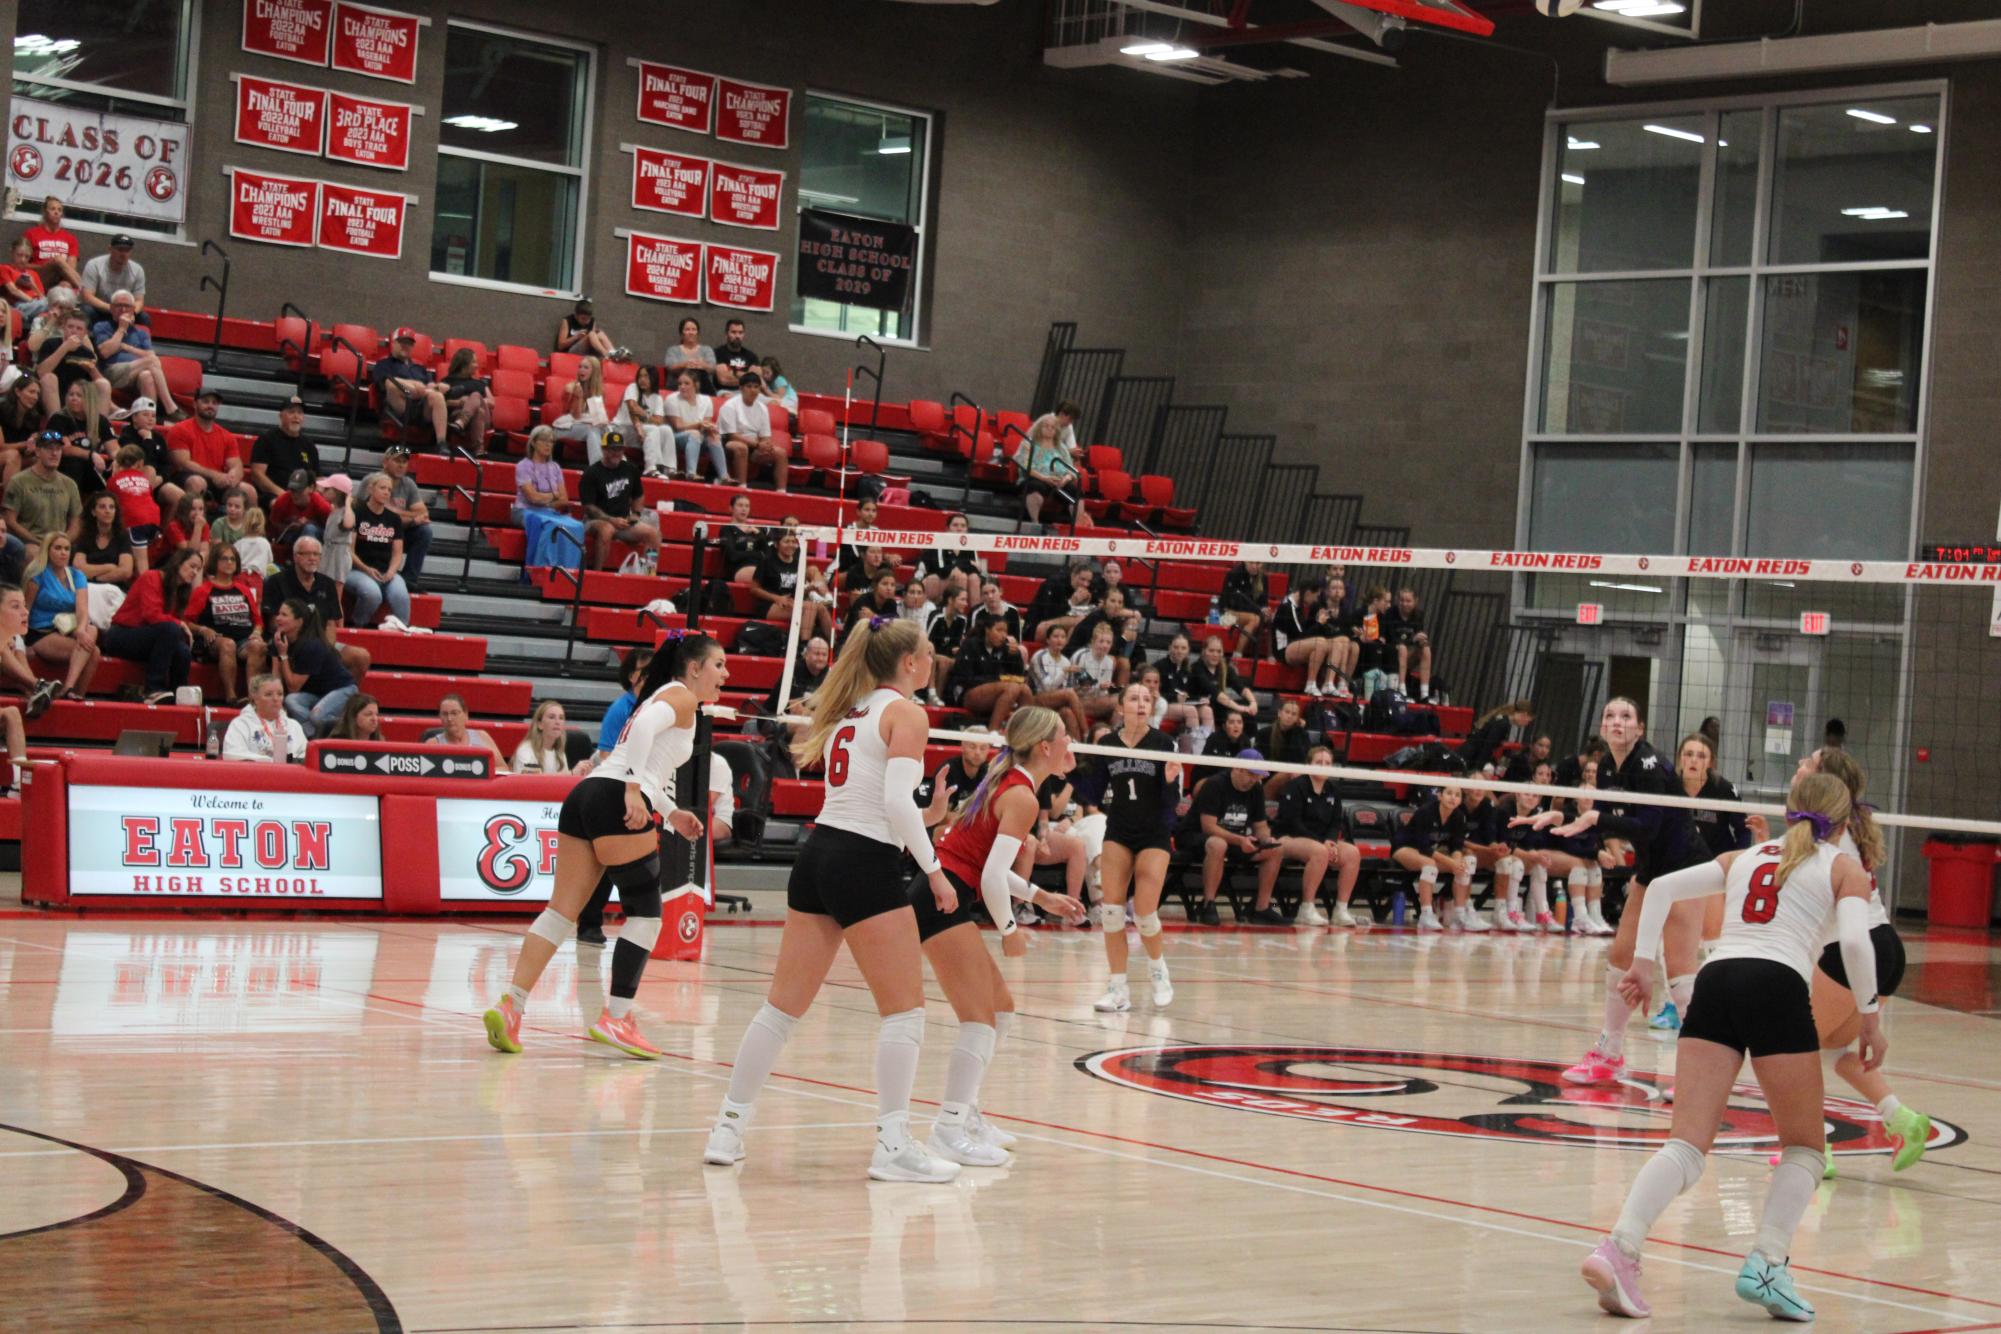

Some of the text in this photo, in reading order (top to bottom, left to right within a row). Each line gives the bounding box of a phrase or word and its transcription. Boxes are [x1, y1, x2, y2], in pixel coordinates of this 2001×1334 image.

[256, 0, 322, 31] CHAMPIONS
[365, 16, 391, 28] STATE
[269, 30, 304, 45] FOOTBALL
[344, 17, 408, 48] CHAMPIONS
[276, 41, 296, 52] EATON
[356, 39, 393, 54] 2023 AAA
[357, 50, 391, 64] BASEBALL
[364, 60, 383, 71] EATON
[669, 73, 687, 83] STATE
[269, 87, 296, 101] STATE
[646, 74, 707, 103] FINAL FOUR
[744, 90, 766, 101] STATE
[248, 89, 315, 122] FINAL FOUR
[356, 105, 382, 117] STATE
[726, 92, 781, 117] CHAMPIONS
[336, 108, 399, 136] 3RD PLACE
[666, 111, 683, 121] EATON
[757, 112, 770, 123] AAA
[258, 120, 300, 137] VOLLEYBALL
[347, 127, 385, 142] 2023 AAA
[742, 129, 761, 139] EATON
[12, 114, 179, 164] CLASS OF
[268, 133, 289, 144] EATON
[343, 137, 387, 152] BOYS TRACK
[355, 149, 375, 160] EATON
[663, 158, 682, 168] STATE
[54, 155, 133, 190] 2026
[640, 159, 702, 186] FINAL FOUR
[738, 174, 757, 184] STATE
[261, 181, 289, 194] STATE
[672, 180, 686, 190] AAA
[716, 174, 777, 200] FINAL FOUR
[240, 182, 308, 212] CHAMPIONS
[354, 195, 374, 207] STATE
[748, 196, 761, 205] AAA
[253, 204, 292, 219] 2023 AAA
[327, 198, 397, 226] FINAL FOUR
[252, 215, 292, 229] WRESTLING
[365, 220, 376, 229] AA
[261, 226, 281, 237] EATON
[345, 226, 374, 239] FOOTBALL
[831, 228, 884, 248] EATON
[350, 236, 369, 246] EATON
[655, 243, 679, 254] STATE
[636, 244, 694, 271] CHAMPIONS
[730, 252, 753, 263] STATE
[800, 240, 911, 269] HIGH SCHOOL
[646, 264, 681, 278] 2024 AAA
[712, 256, 769, 283] FINAL FOUR
[816, 259, 892, 282] CLASS OF
[648, 276, 678, 287] BASEBALL
[723, 274, 757, 288] 2024 AAA
[654, 285, 672, 294] EATON
[367, 535, 389, 543] Reds
[855, 531, 934, 545] EATON REDS
[994, 536, 1080, 551] EATON REDS
[1145, 541, 1239, 556] EATON REDS
[1310, 546, 1413, 563] EATON REDS
[1490, 552, 1603, 569] EATON REDS
[1687, 557, 1812, 575] EATON REDS
[1904, 563, 1978, 580] EATON
[1579, 604, 1598, 624] EXIT
[1804, 613, 1825, 632] EXIT
[828, 725, 856, 788] 6
[336, 757, 354, 767] BONUS
[390, 757, 420, 773] POSS
[1128, 778, 1138, 800] 1
[191, 795, 264, 810] Welcome to
[540, 807, 560, 820] Ho
[121, 815, 333, 871] EATON
[133, 875, 324, 894] HIGH SCHOOL
[1741, 862, 1782, 925] 8
